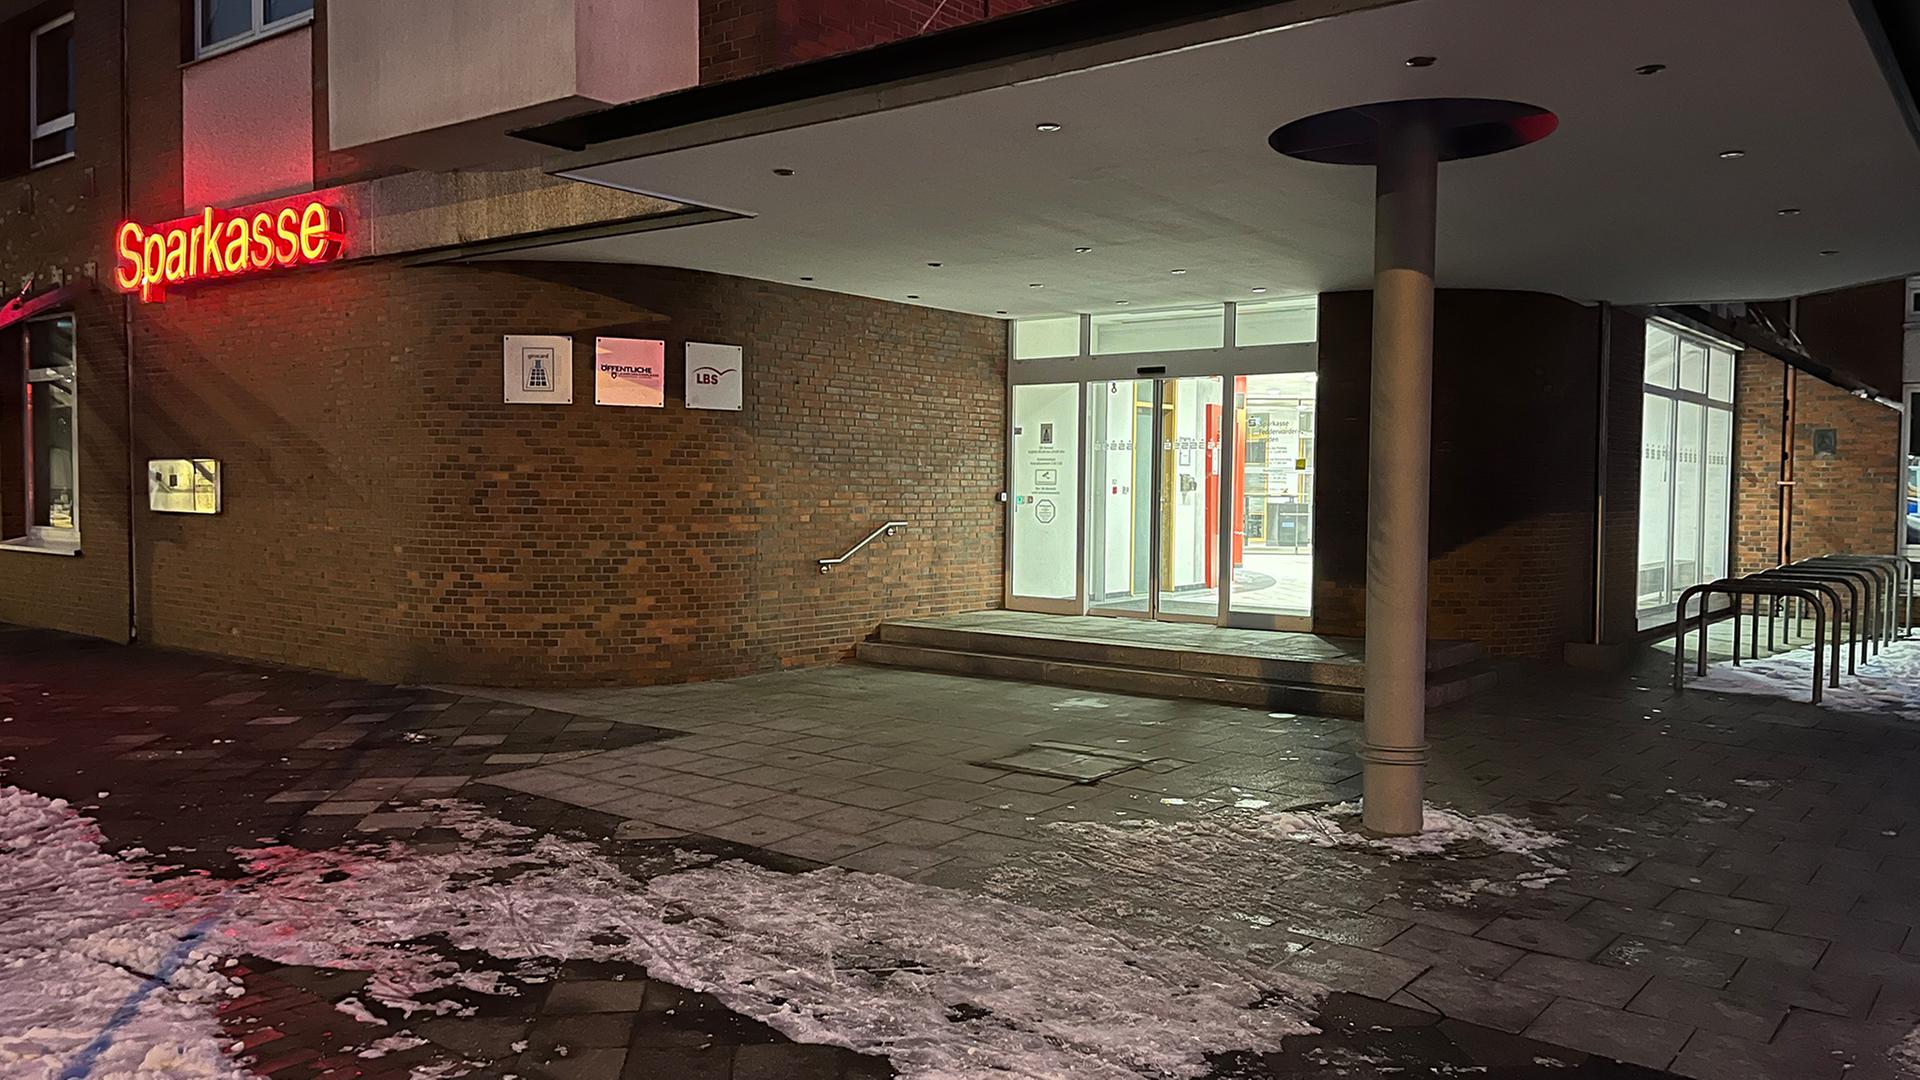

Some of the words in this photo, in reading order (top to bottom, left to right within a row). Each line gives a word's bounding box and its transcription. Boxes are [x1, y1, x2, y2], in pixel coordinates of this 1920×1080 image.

[116, 201, 330, 303] Sparkasse
[600, 364, 652, 374] ÖFFENTLICHE
[696, 373, 719, 385] LBS
